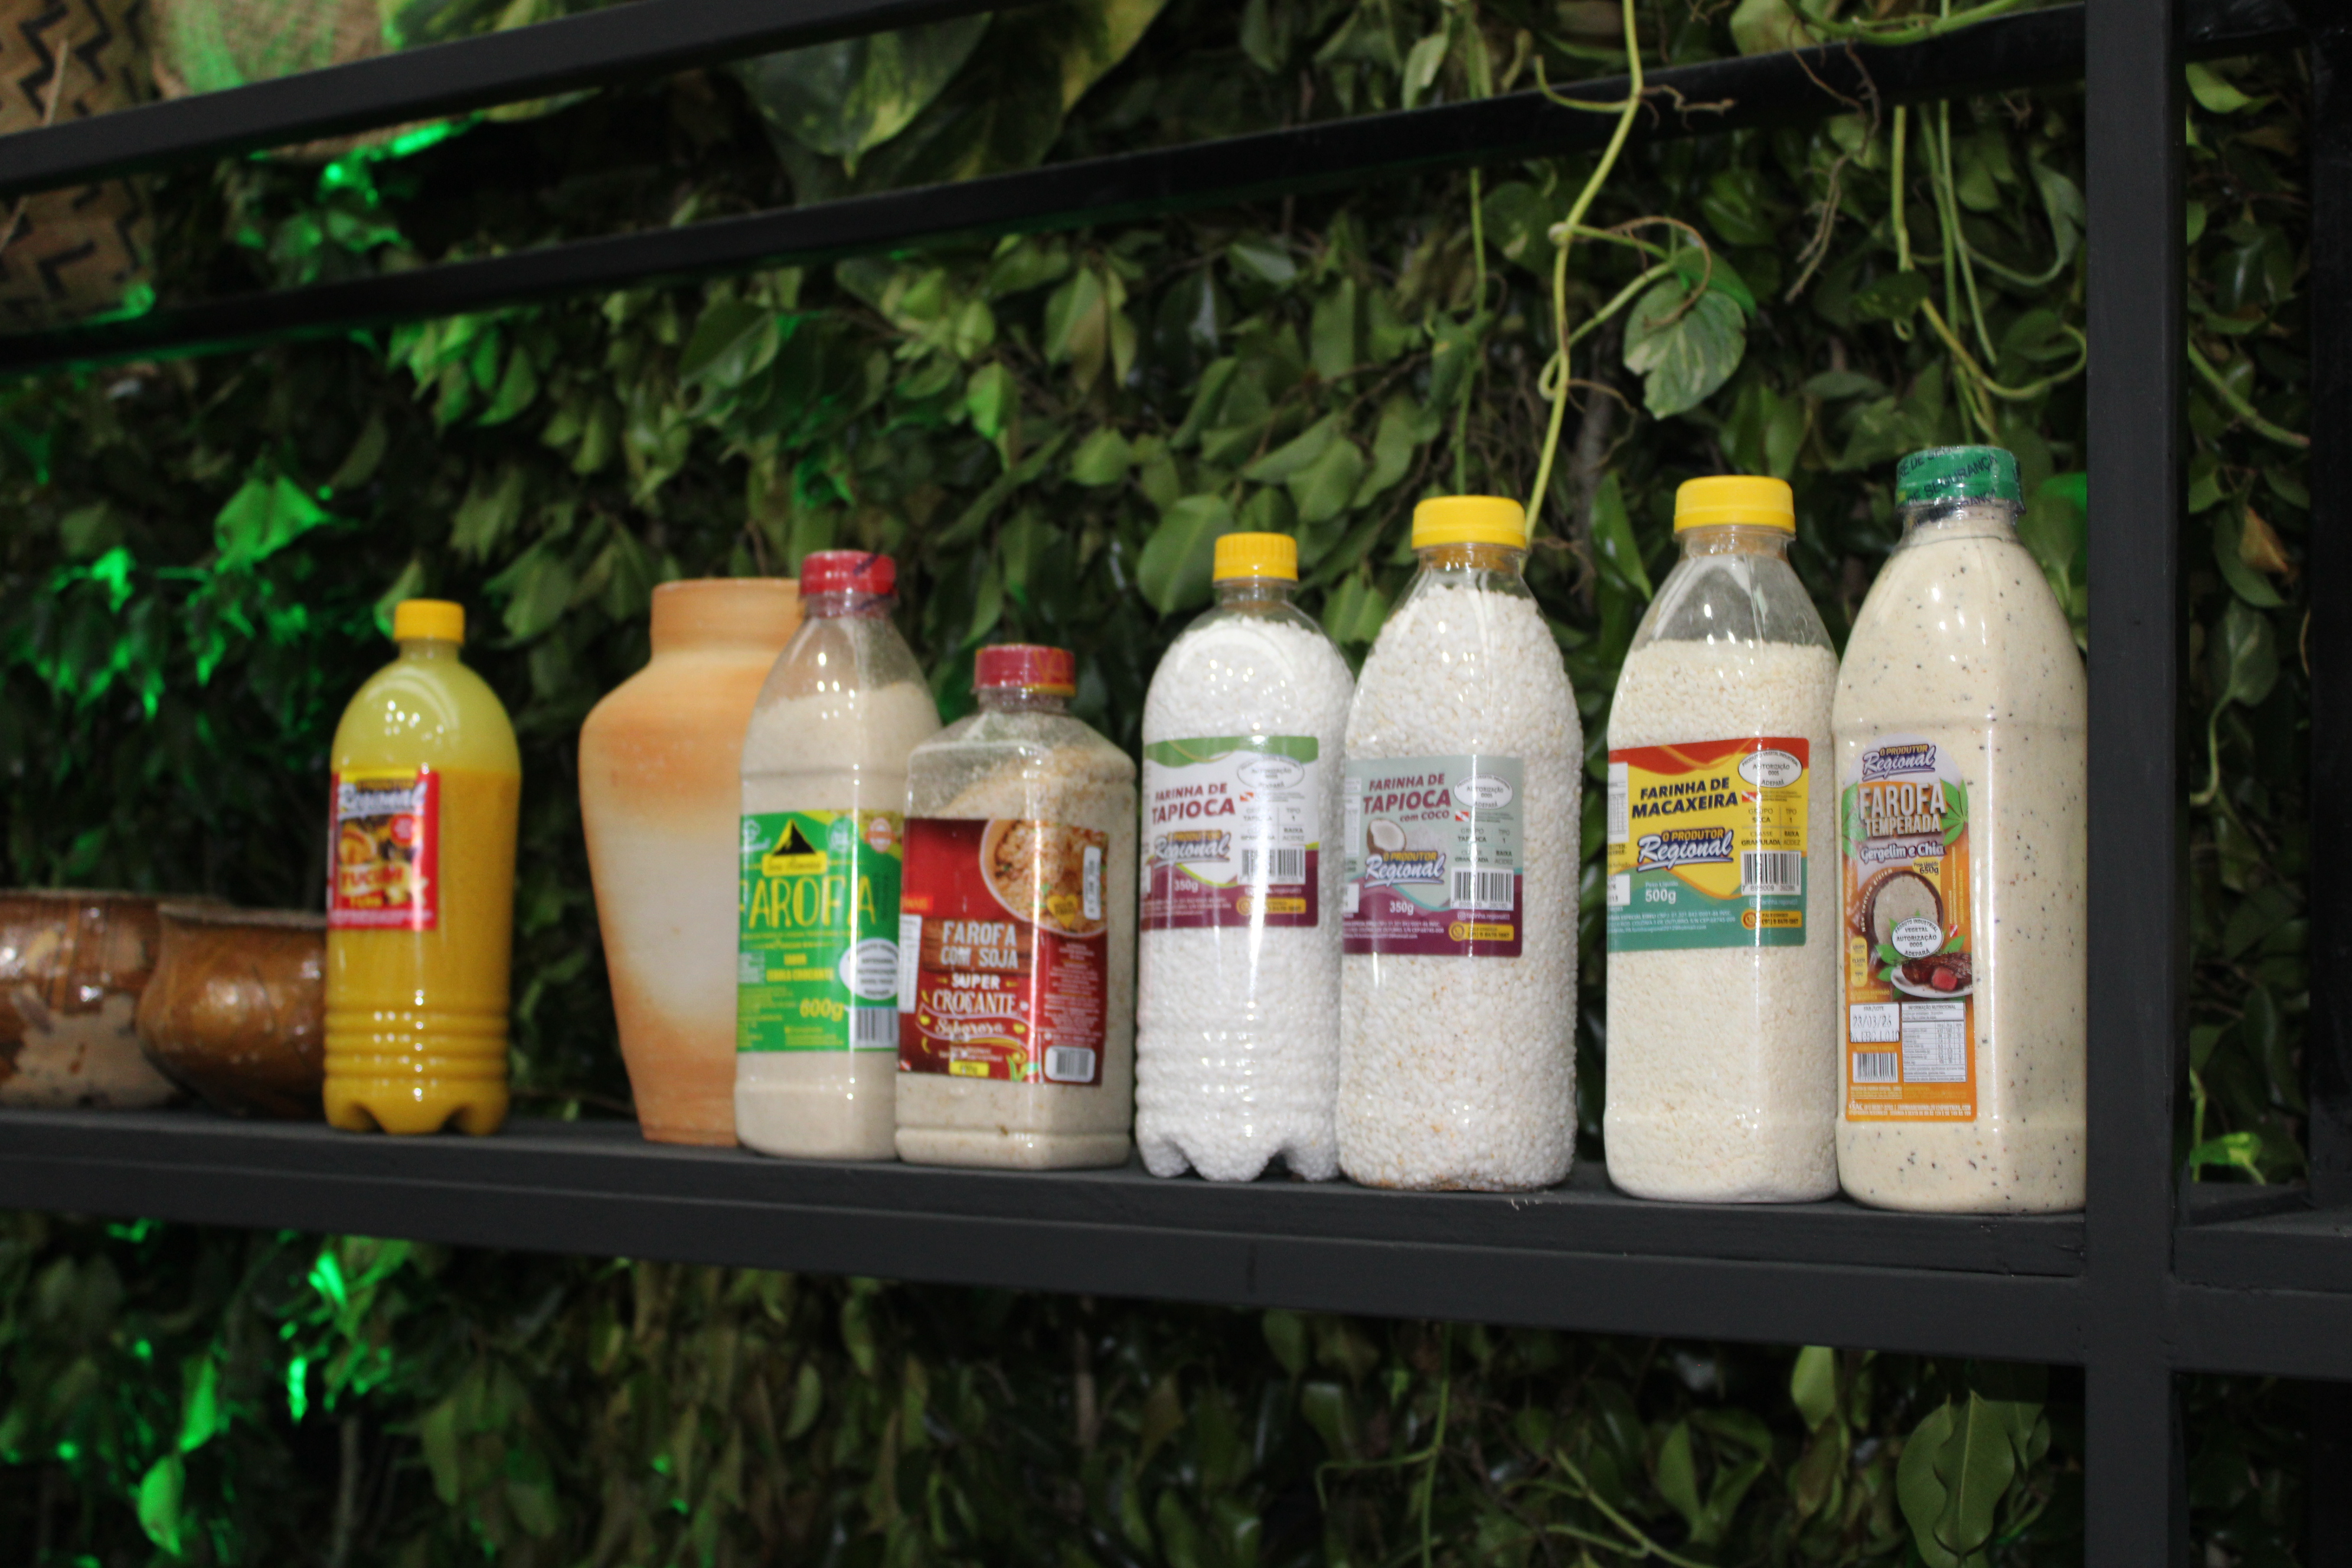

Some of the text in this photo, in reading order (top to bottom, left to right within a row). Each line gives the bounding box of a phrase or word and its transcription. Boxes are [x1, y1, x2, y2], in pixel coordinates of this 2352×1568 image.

[1880, 744, 1929, 756] O PRODUTOR
[1863, 745, 1936, 780] Regional
[1368, 773, 1445, 792] FARINHA DE
[1640, 777, 1730, 801] FARINHA DE
[1761, 778, 1785, 786] ADEPARÁ
[1155, 783, 1227, 803] FARINHA DE
[1363, 789, 1452, 815] TAPIOCA
[1860, 782, 1947, 819] FAROFA
[1152, 798, 1235, 825] TAPIOCA
[1631, 791, 1739, 819] MACAXEIRA
[1399, 810, 1450, 822] com COCO
[1865, 814, 1942, 837] TEMPERADA
[1662, 827, 1724, 842] O PRODUTOR
[1390, 850, 1438, 862] PRODUTOR
[1637, 828, 1734, 870] Regional
[1861, 841, 1946, 864] Gergelim e Chia
[1365, 852, 1446, 887] Regional
[1919, 866, 1939, 875] 650g
[1645, 888, 1677, 904] 500g
[1389, 900, 1415, 915] 350g
[942, 921, 1018, 947] FAROFA
[1895, 919, 1939, 934] PRODUTO INDUSTRIAL
[1896, 934, 1937, 942] AUTORIZAÇÃO
[940, 946, 1019, 969] COM SOJA
[1905, 948, 1930, 956] ADEPARÁ
[951, 974, 1001, 989] SUPER
[800, 997, 845, 1022] 600g
[932, 988, 1017, 1015] CROCANTE
